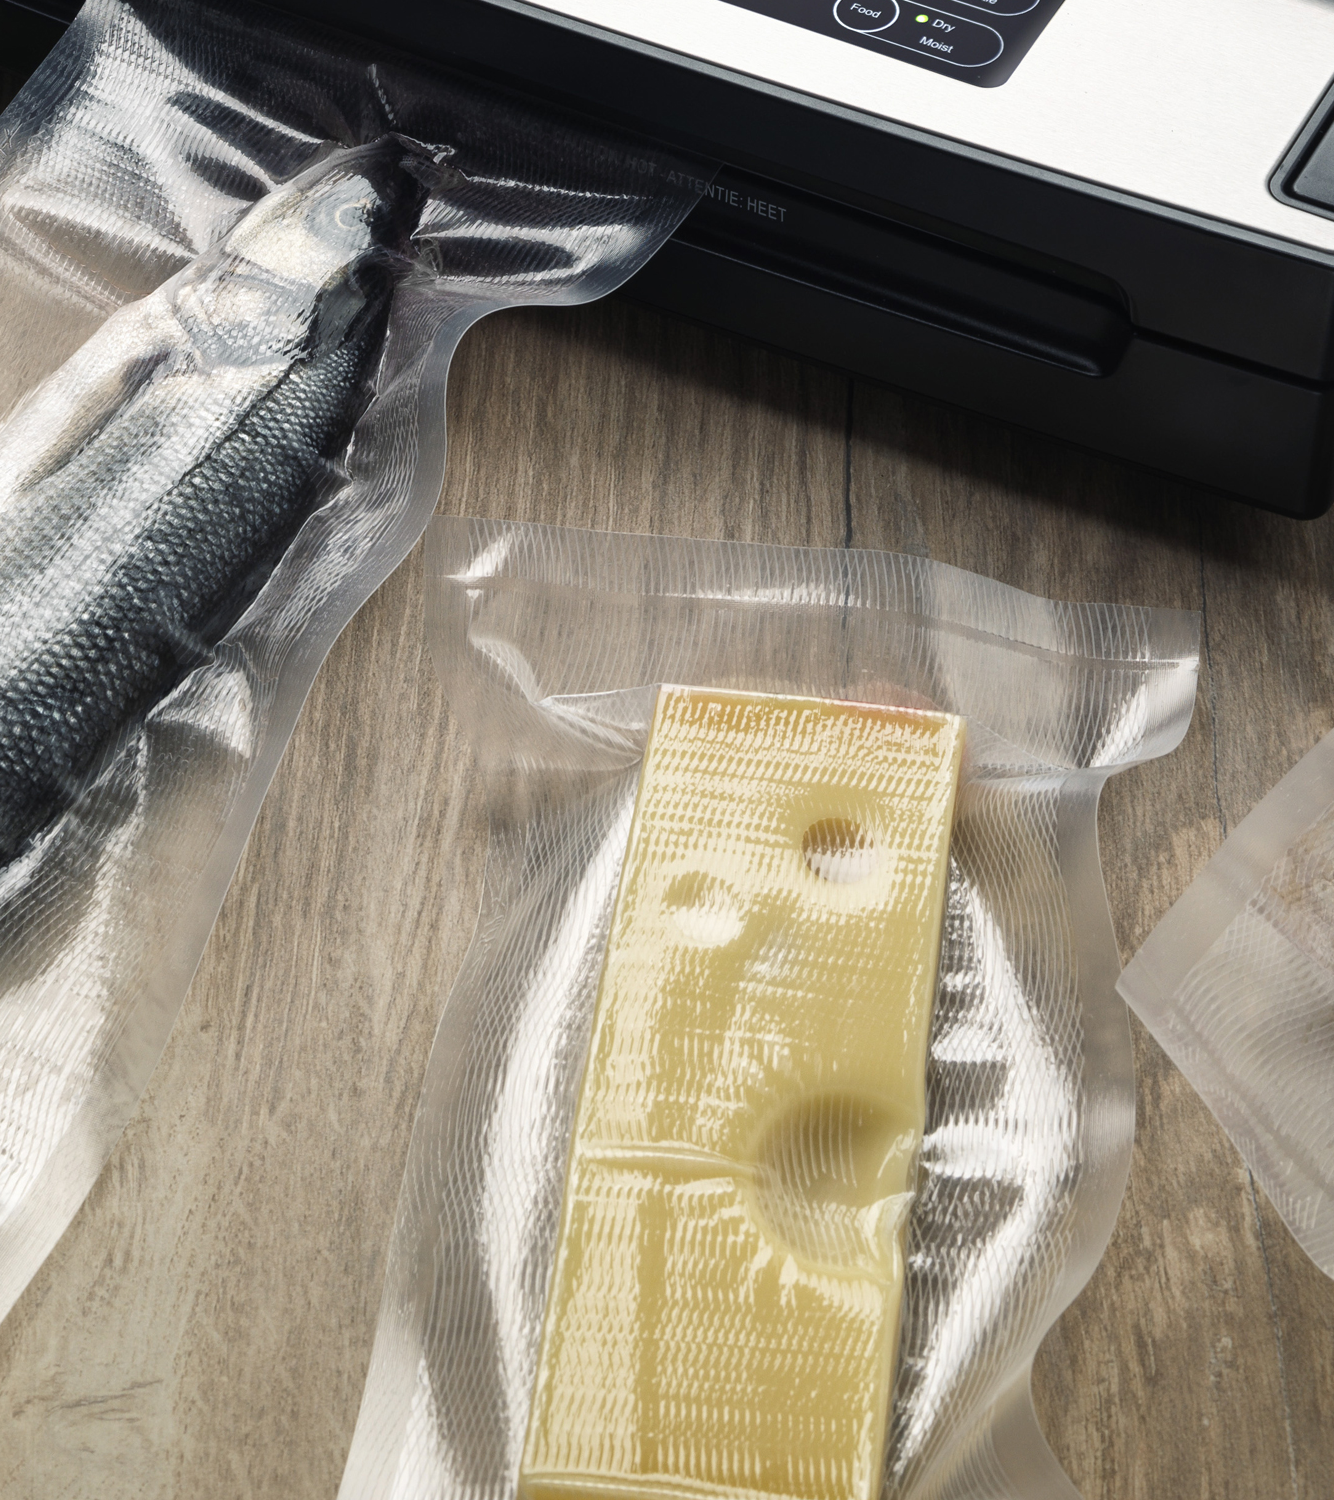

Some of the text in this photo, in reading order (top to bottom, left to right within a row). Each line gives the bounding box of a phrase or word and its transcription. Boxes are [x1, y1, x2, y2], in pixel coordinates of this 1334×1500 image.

[850, 2, 882, 19] Food
[932, 18, 956, 32] Dry
[919, 36, 954, 53] Moist
[747, 196, 787, 222] HEET
